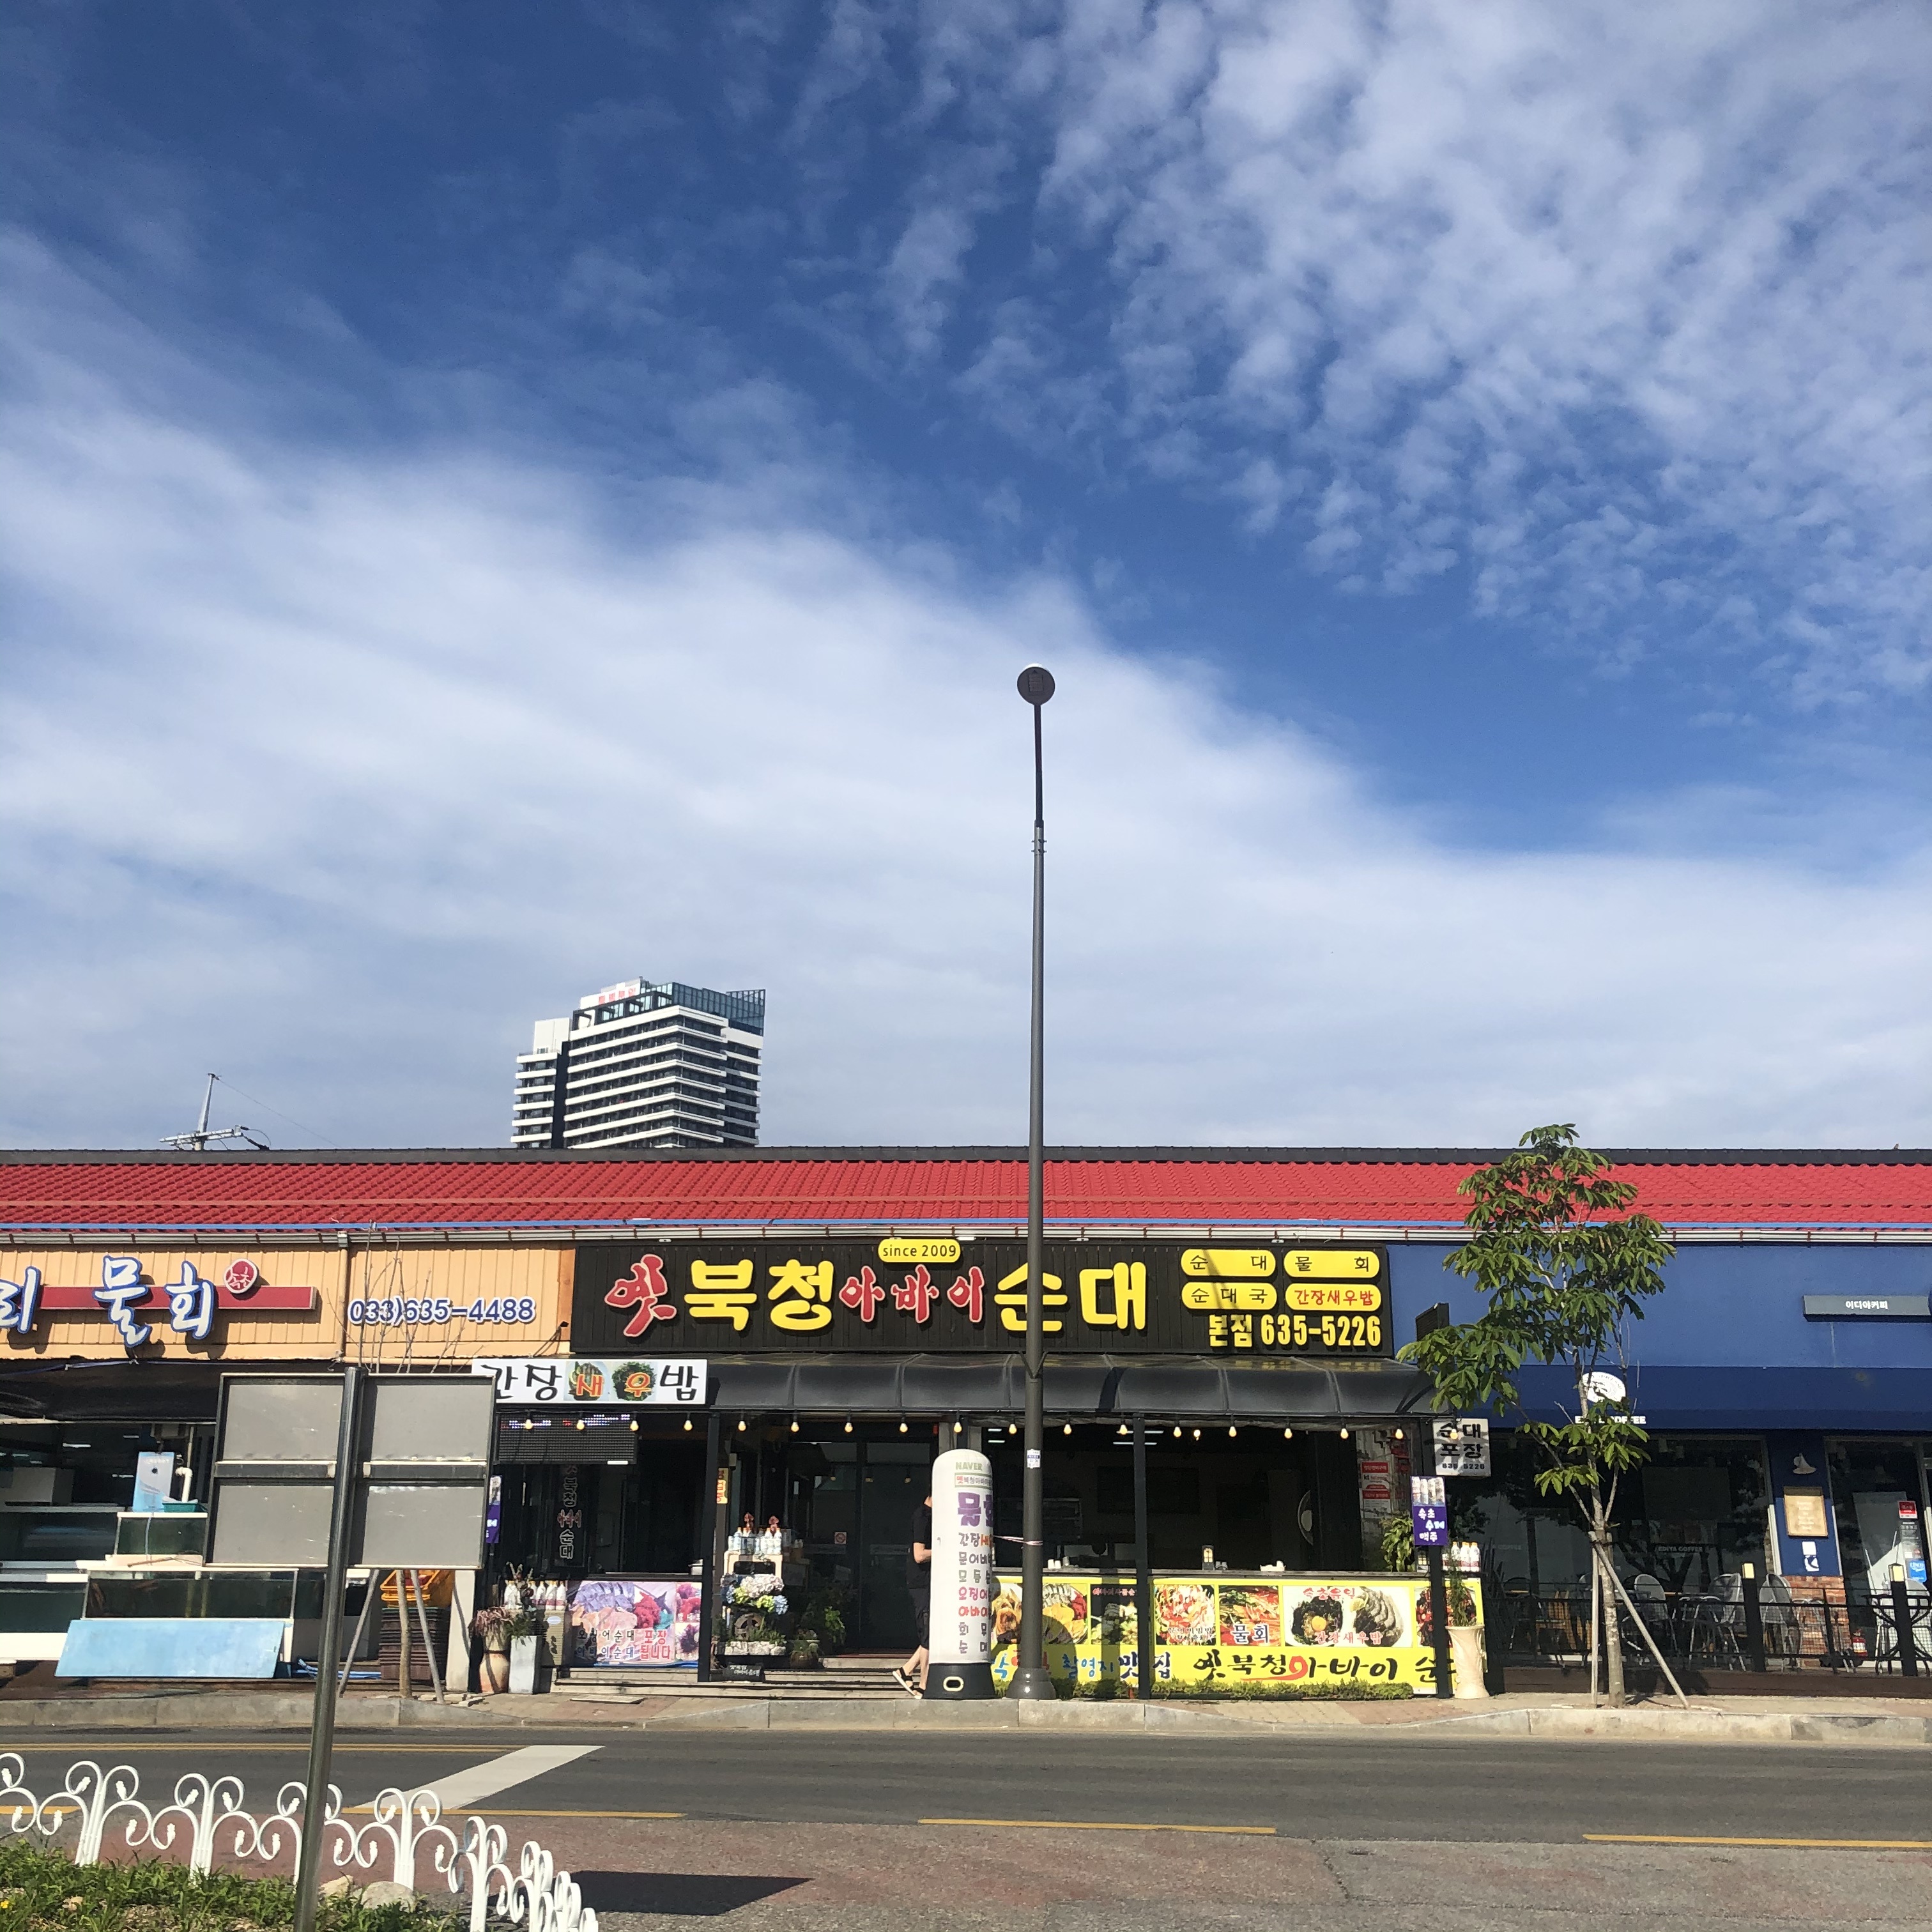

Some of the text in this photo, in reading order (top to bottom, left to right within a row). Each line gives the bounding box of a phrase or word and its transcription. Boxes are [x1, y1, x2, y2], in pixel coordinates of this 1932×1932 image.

[883, 1244, 956, 1257] since 2009
[93, 1255, 217, 1347] 물회
[1294, 1290, 1374, 1306] 간장새우밥
[1845, 1300, 1889, 1310] 이디야커피
[348, 1296, 536, 1326] 033)635-4488
[1209, 1315, 1381, 1347] 본점 635-5226
[1439, 1443, 1483, 1459] 포장
[956, 1462, 982, 1471] NAVER
[645, 1630, 667, 1644] 포장
[1232, 1623, 1270, 1644] 물회
[1315, 1630, 1383, 1644] 간장새우밥
[640, 1644, 671, 1660] 됩니다
